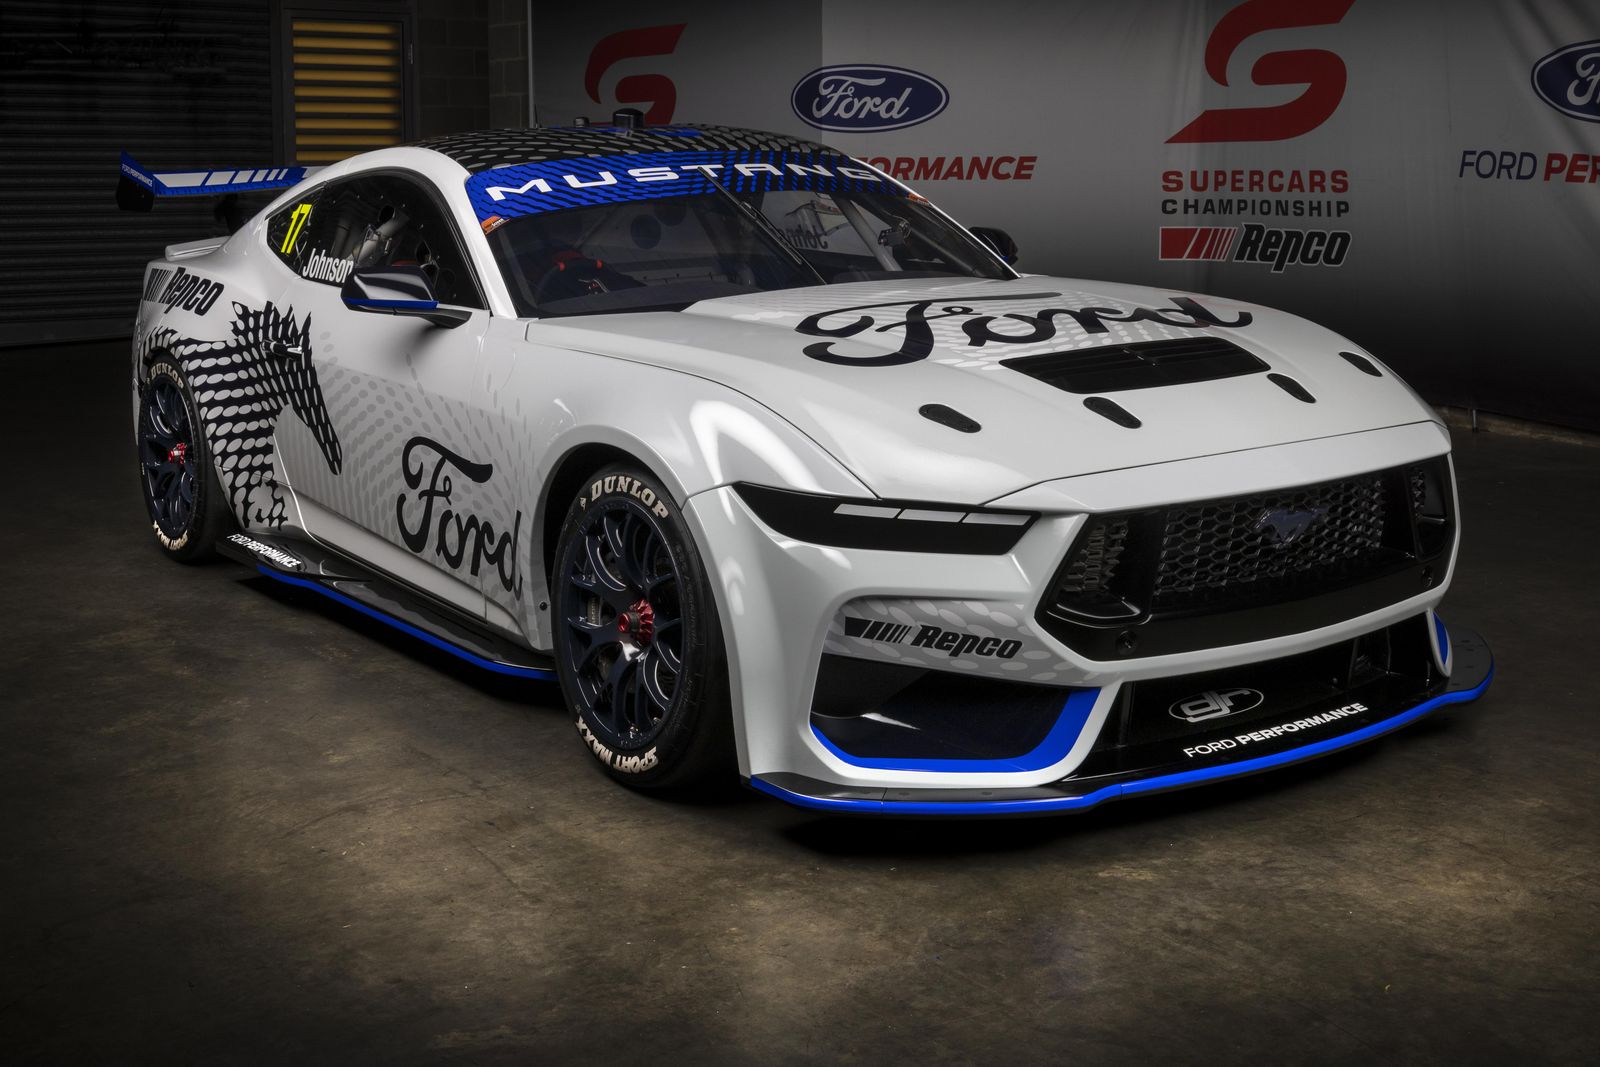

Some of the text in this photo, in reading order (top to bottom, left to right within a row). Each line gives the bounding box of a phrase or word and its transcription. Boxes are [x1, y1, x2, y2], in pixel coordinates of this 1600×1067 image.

[812, 75, 912, 120] Ford
[485, 162, 882, 201] MUSTANG
[858, 156, 1037, 181] ORMANCE
[1161, 169, 1350, 194] SUPERCARS
[1459, 150, 1538, 181] FORD
[281, 203, 313, 255] 17
[1161, 198, 1351, 218] CHAMPIONSHIP
[302, 247, 354, 284] Johnson
[1233, 222, 1352, 274] Repco
[158, 266, 225, 317] Repco
[795, 291, 1253, 367] Ford
[396, 436, 523, 601] Ford
[591, 475, 669, 519] DUNLOP
[909, 623, 1024, 660] Repco
[575, 714, 659, 774] SPORT MAXX
[1183, 702, 1368, 758] FORD PERFORMANCE
